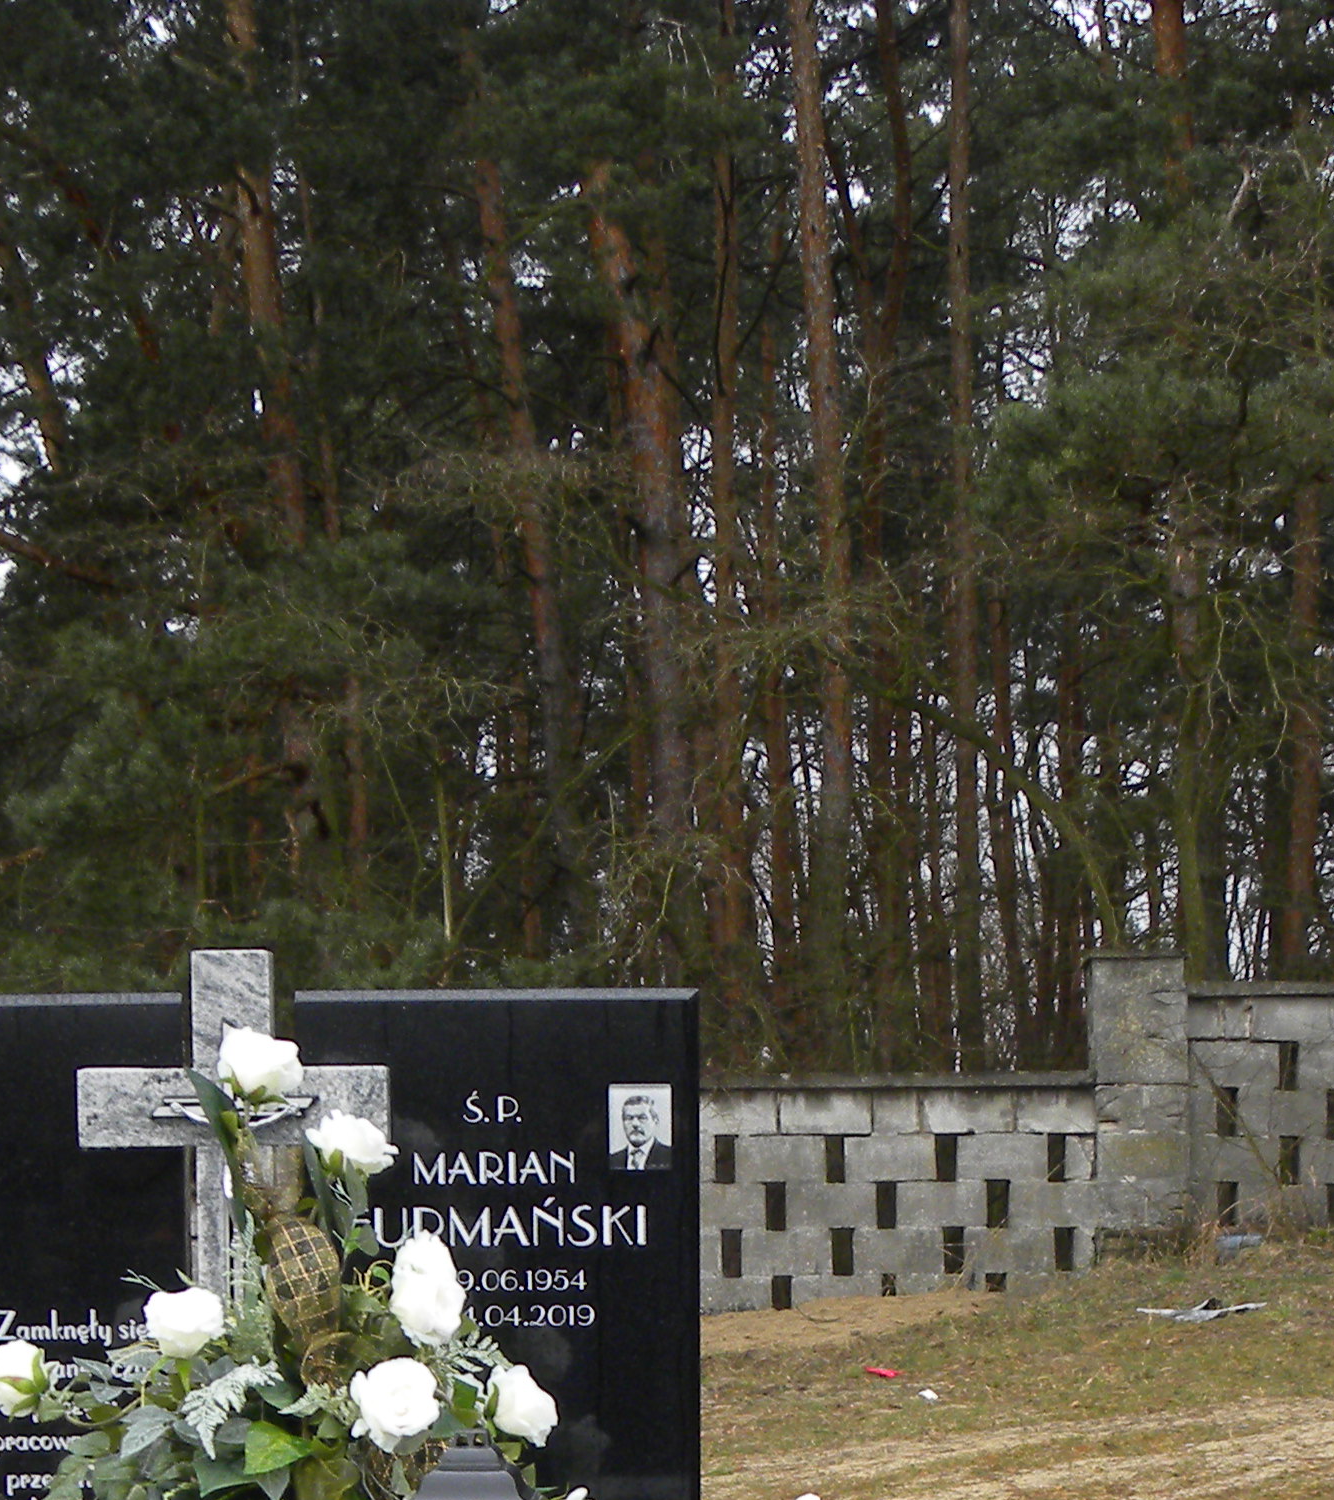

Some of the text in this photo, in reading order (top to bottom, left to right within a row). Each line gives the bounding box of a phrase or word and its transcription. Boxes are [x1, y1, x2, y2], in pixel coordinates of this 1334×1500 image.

[413, 1150, 575, 1185] MARIAN
[353, 1197, 647, 1248] URMAŃSKI
[457, 1268, 587, 1292] 9.06.1954
[464, 1304, 595, 1327] 4.04.2019
